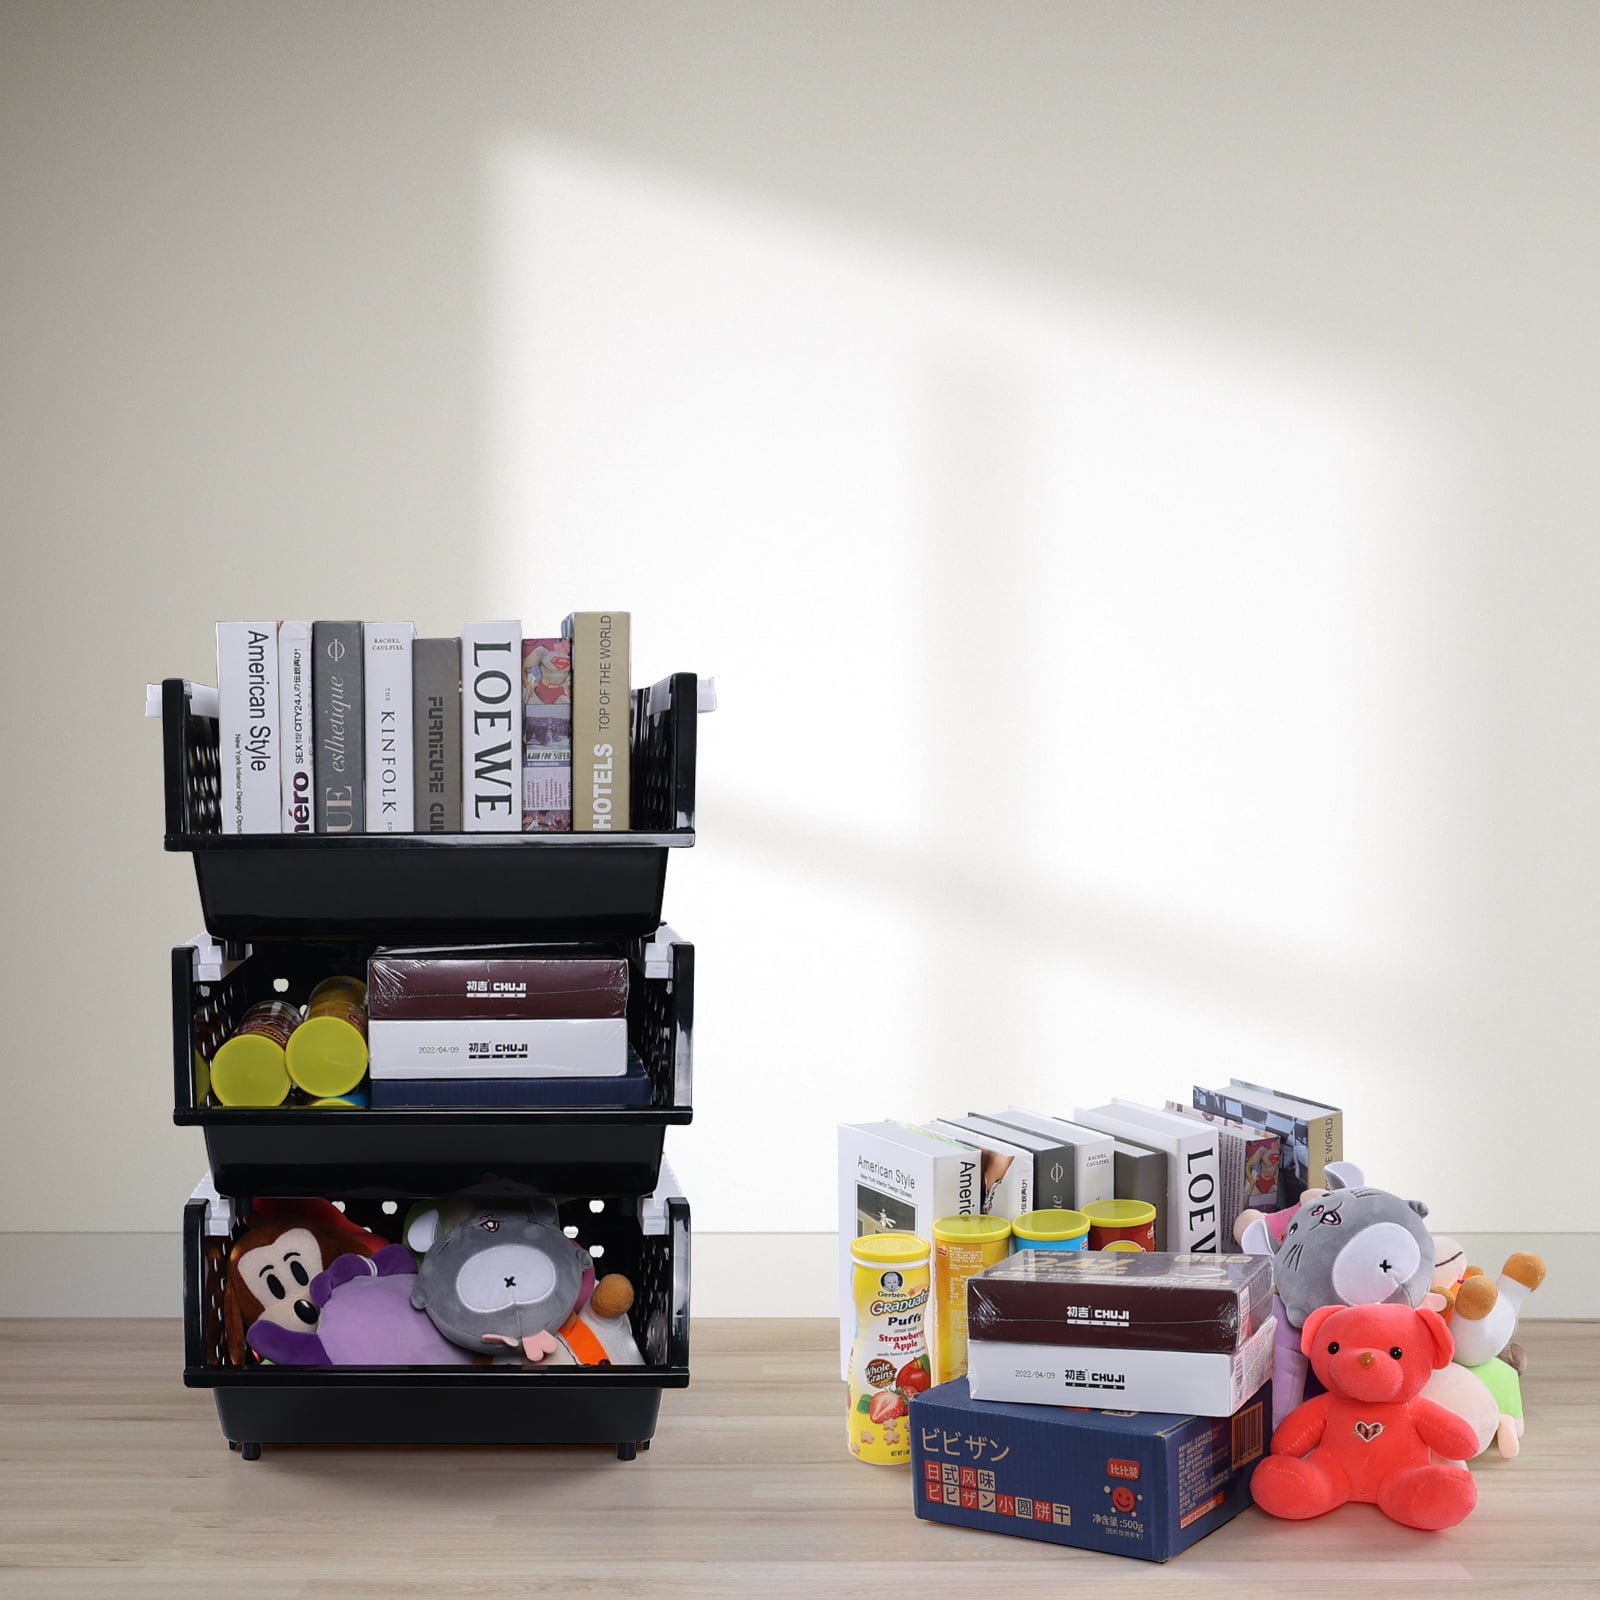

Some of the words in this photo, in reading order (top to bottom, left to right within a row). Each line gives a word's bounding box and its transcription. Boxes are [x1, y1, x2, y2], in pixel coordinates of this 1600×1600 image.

[600, 615, 612, 661] WORLD
[247, 630, 270, 719] American
[600, 662, 611, 687] THE
[599, 688, 610, 708] OF
[473, 641, 513, 820] LOEWE
[599, 709, 610, 731] TOP
[244, 725, 272, 772] Style
[295, 745, 304, 764] SEX
[381, 710, 397, 815] KINFOLK
[592, 743, 613, 831] HOTELS
[235, 790, 243, 814] Design
[493, 982, 527, 992] CHUJI
[418, 1046, 459, 1054] 2022/04/09
[494, 1043, 528, 1052] CHUJI
[1325, 1117, 1333, 1153] WORLD
[857, 1154, 894, 1181] American
[895, 1168, 915, 1190] Style
[877, 1291, 905, 1299] Gerber
[887, 1313, 922, 1327] Puffs
[1094, 1308, 1130, 1321] CHUJI
[878, 1330, 924, 1342] Strawberry
[893, 1340, 918, 1351] Apple
[1015, 1369, 1056, 1380] 2022/04/09
[1091, 1372, 1126, 1384] CHUJI
[921, 1427, 1010, 1462] ビビザン
[926, 1463, 995, 1490] 日式风味
